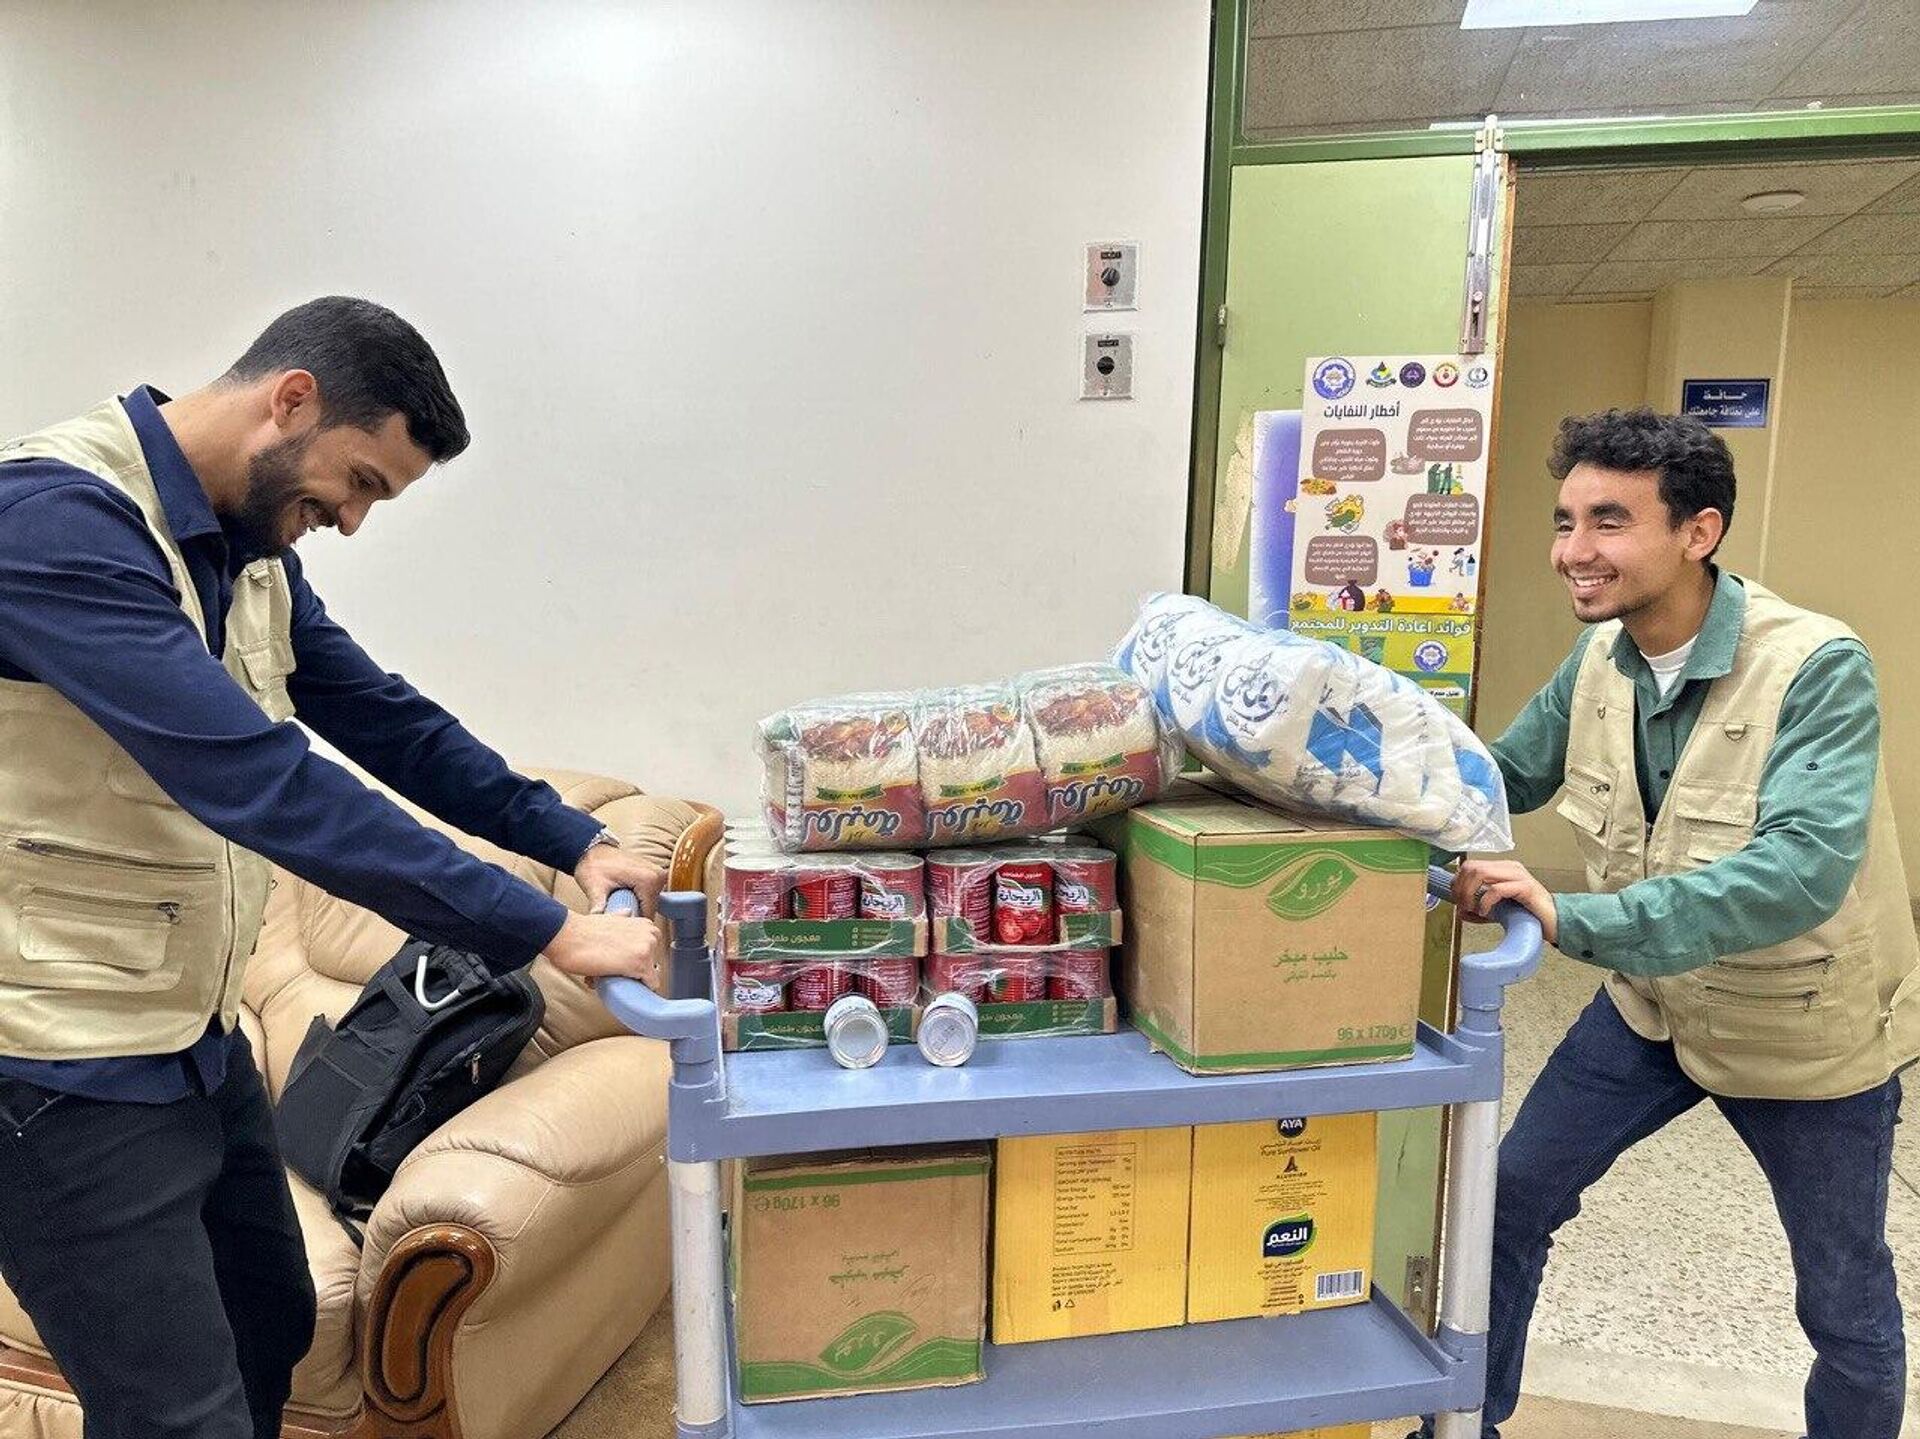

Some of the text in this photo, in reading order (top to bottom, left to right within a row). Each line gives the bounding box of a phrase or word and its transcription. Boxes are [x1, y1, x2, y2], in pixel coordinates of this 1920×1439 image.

[1324, 400, 1400, 420] أخطار النفايات
[1289, 618, 1472, 637] فوائد اعادة التدوير للمجتمع
[1047, 775, 1144, 824] لوليمة
[802, 804, 901, 844] لوليمة
[926, 796, 1025, 840] لوليمة
[863, 895, 903, 911] الريحان
[999, 889, 1042, 905] الريحان
[1273, 946, 1349, 968] حليب مبخر
[1337, 1027, 1352, 1041] 96
[1355, 1028, 1364, 1039] x
[1369, 1024, 1398, 1042] 170g
[1281, 1119, 1302, 1129] AYA
[1261, 1144, 1321, 1157] Pure Sunflower Oil
[773, 1196, 807, 1210] 170g
[811, 1195, 819, 1206] x
[823, 1195, 841, 1209] 96
[1266, 1226, 1308, 1247] النعم
[828, 1269, 868, 1289] حليب
